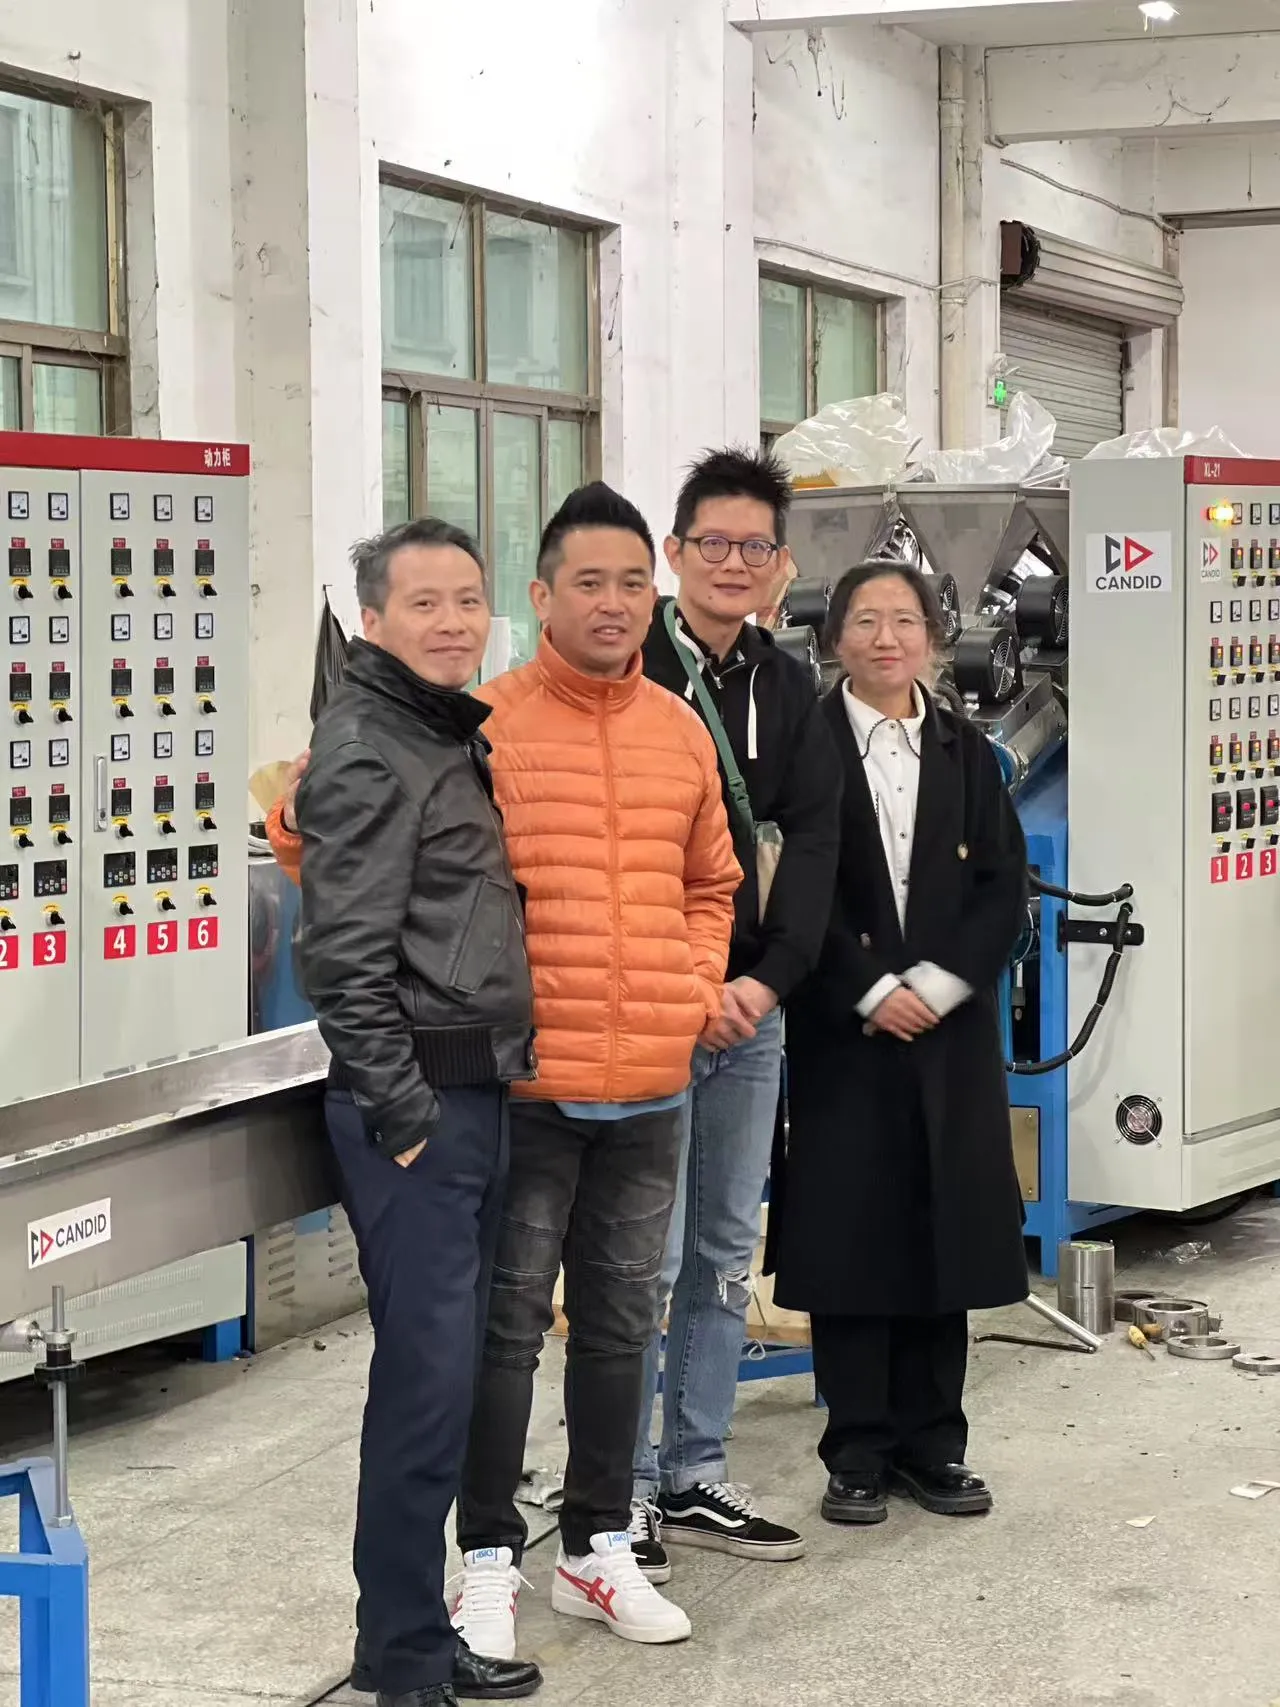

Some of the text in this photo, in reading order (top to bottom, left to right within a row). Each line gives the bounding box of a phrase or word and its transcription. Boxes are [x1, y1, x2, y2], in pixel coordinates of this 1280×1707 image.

[203, 447, 232, 467] 动力柜
[1203, 462, 1221, 477] XL-21
[1095, 575, 1162, 590] CANDID
[1216, 851, 1272, 880] 1 2 3
[43, 934, 57, 962] 3
[113, 928, 127, 955] 4
[156, 924, 169, 950] 5
[197, 920, 209, 946] 6
[55, 1213, 107, 1247] CANDID
